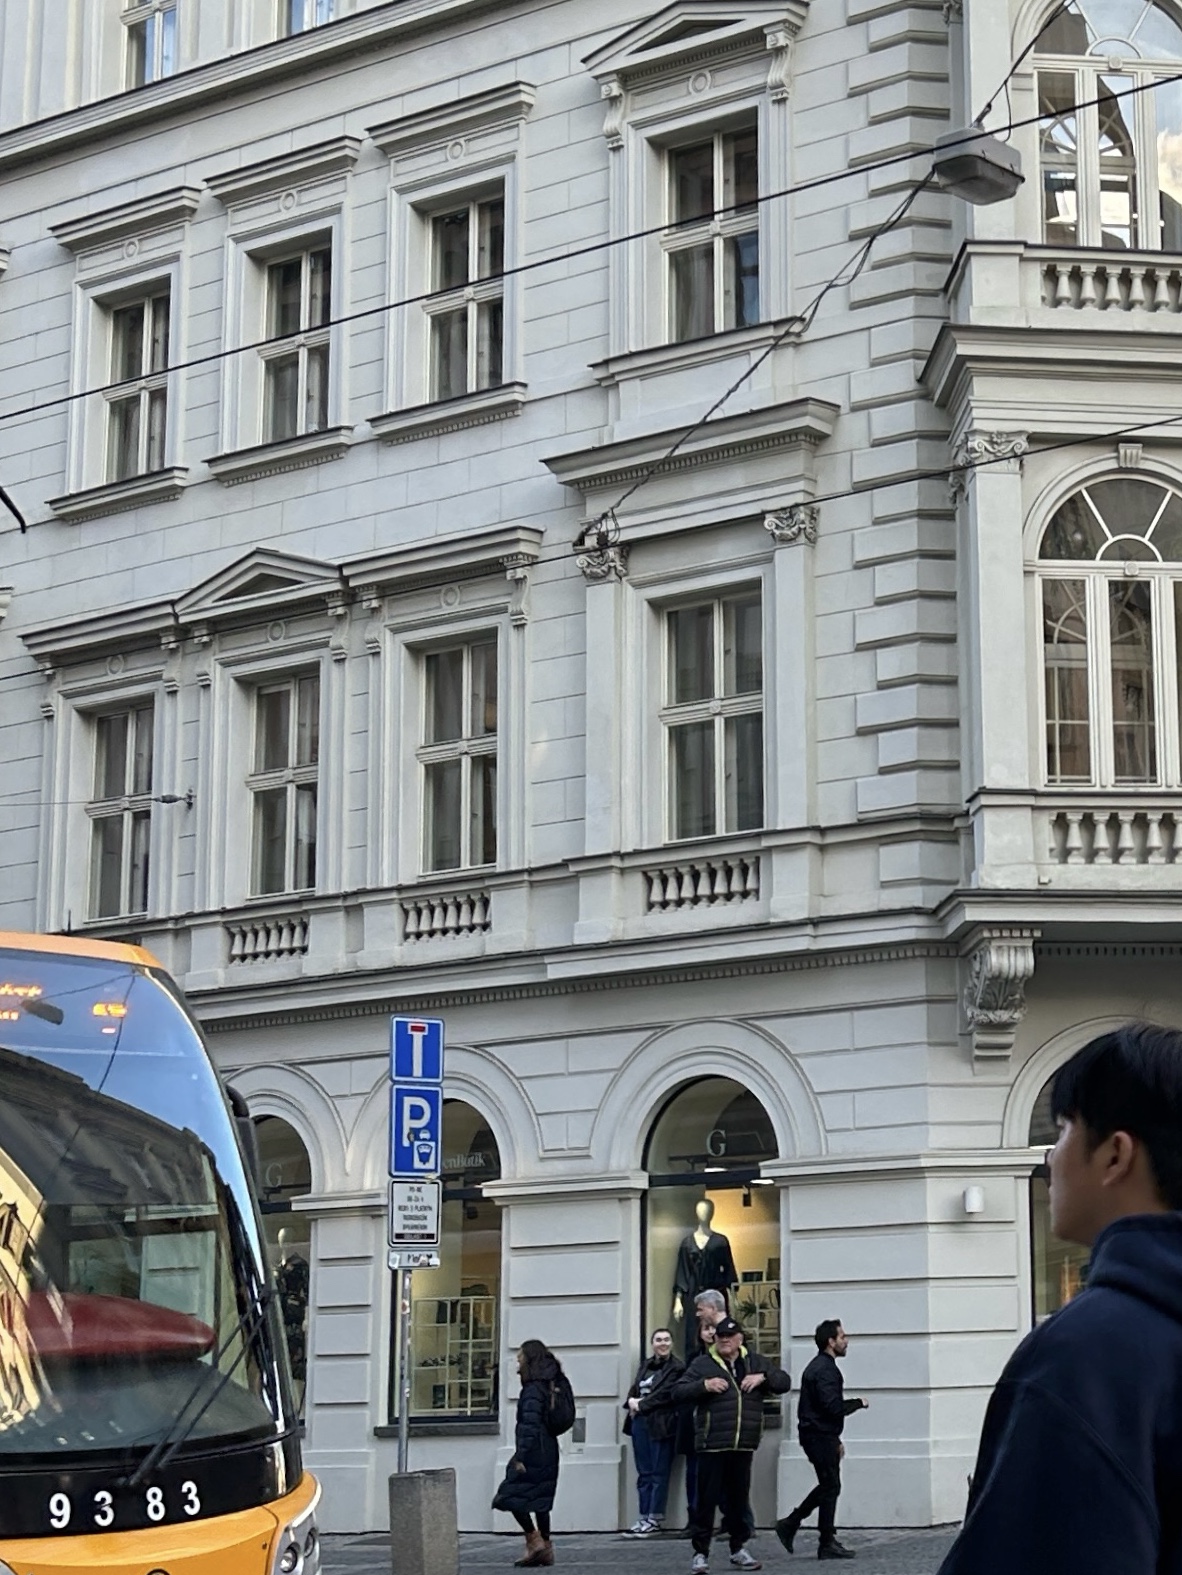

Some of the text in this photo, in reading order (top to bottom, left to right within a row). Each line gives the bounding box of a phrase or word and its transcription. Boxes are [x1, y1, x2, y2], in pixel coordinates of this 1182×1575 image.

[403, 1096, 431, 1147] P
[706, 1129, 727, 1157] G
[49, 1480, 201, 1529] 9383
